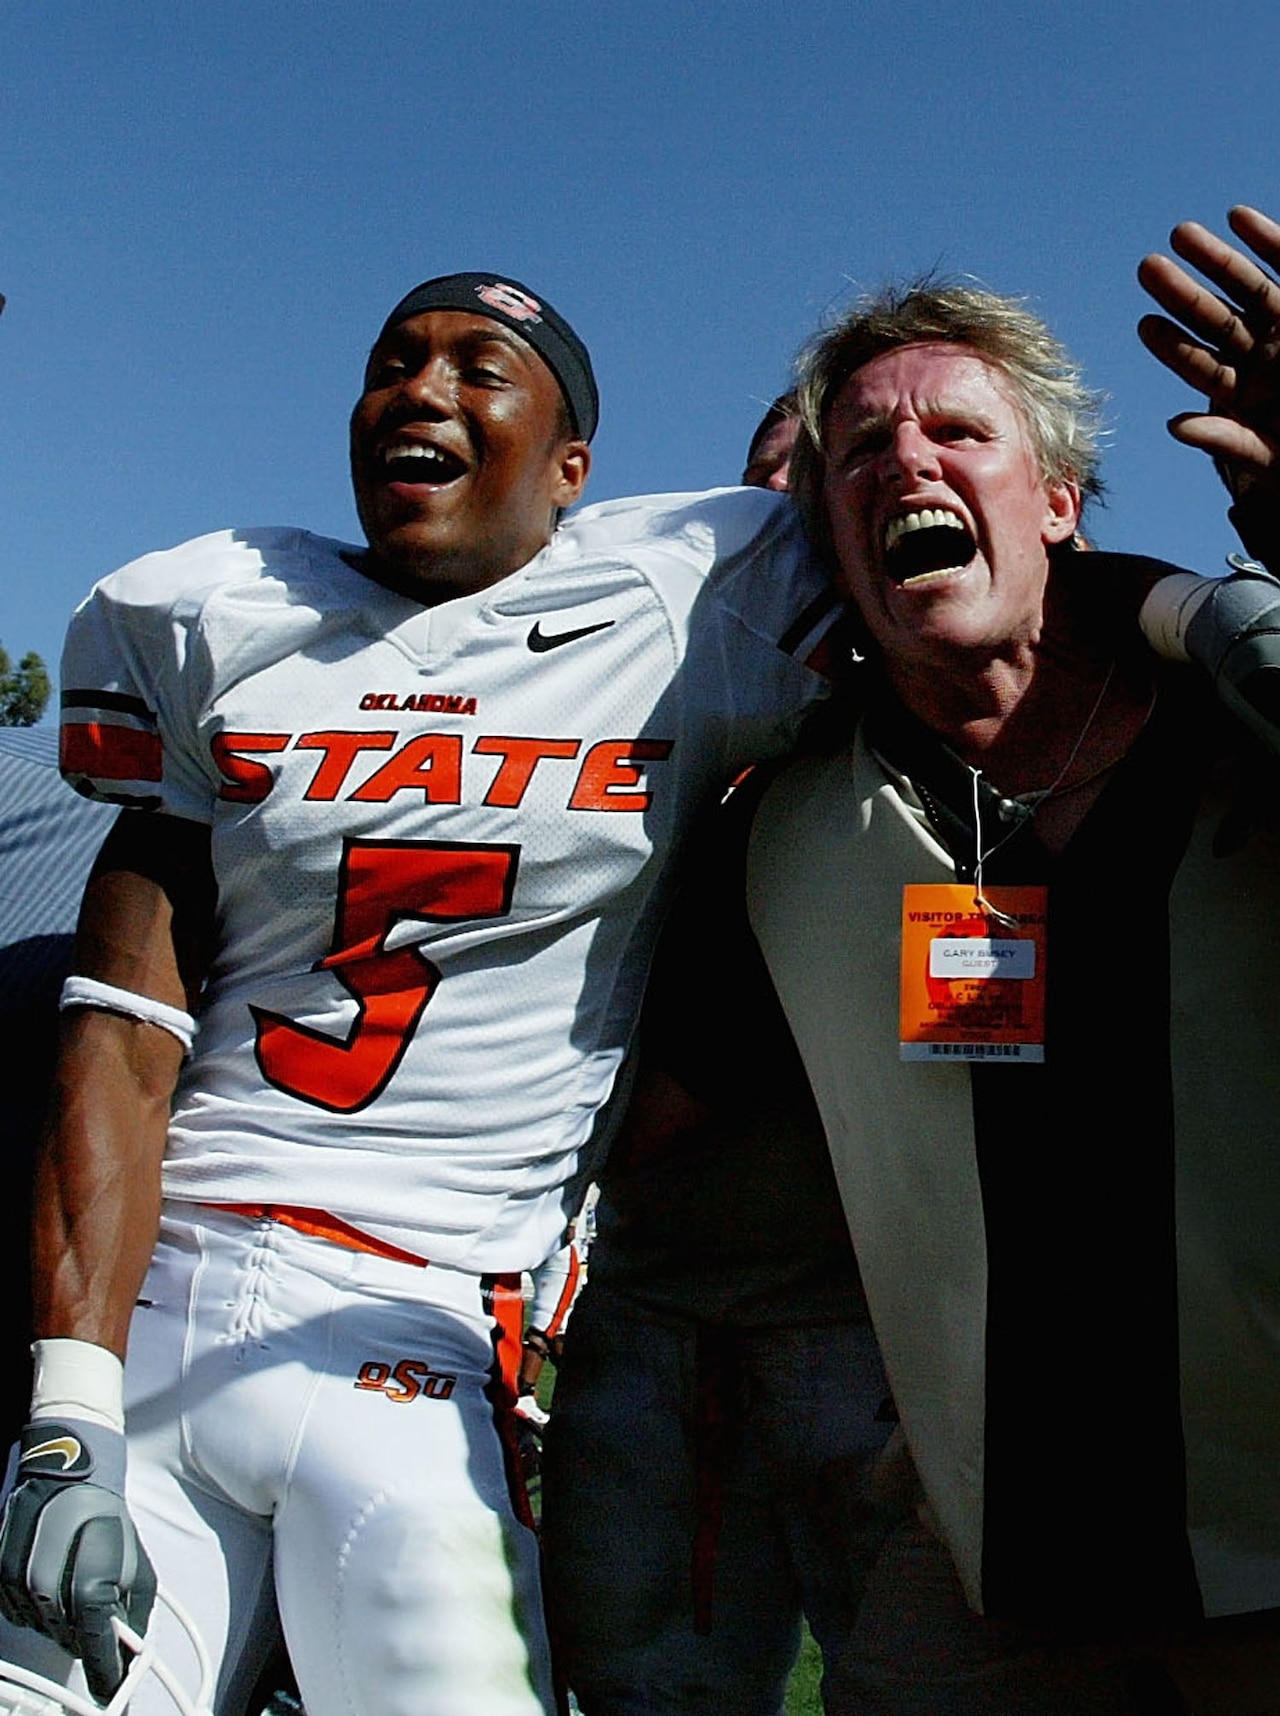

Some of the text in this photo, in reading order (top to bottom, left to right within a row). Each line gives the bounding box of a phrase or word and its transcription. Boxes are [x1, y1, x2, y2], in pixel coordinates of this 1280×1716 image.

[359, 692, 477, 715] OKLAHOMA
[212, 731, 674, 813] STATE
[908, 912, 963, 922] VISITOR
[943, 949, 974, 958] GARY
[249, 837, 520, 1114] 5
